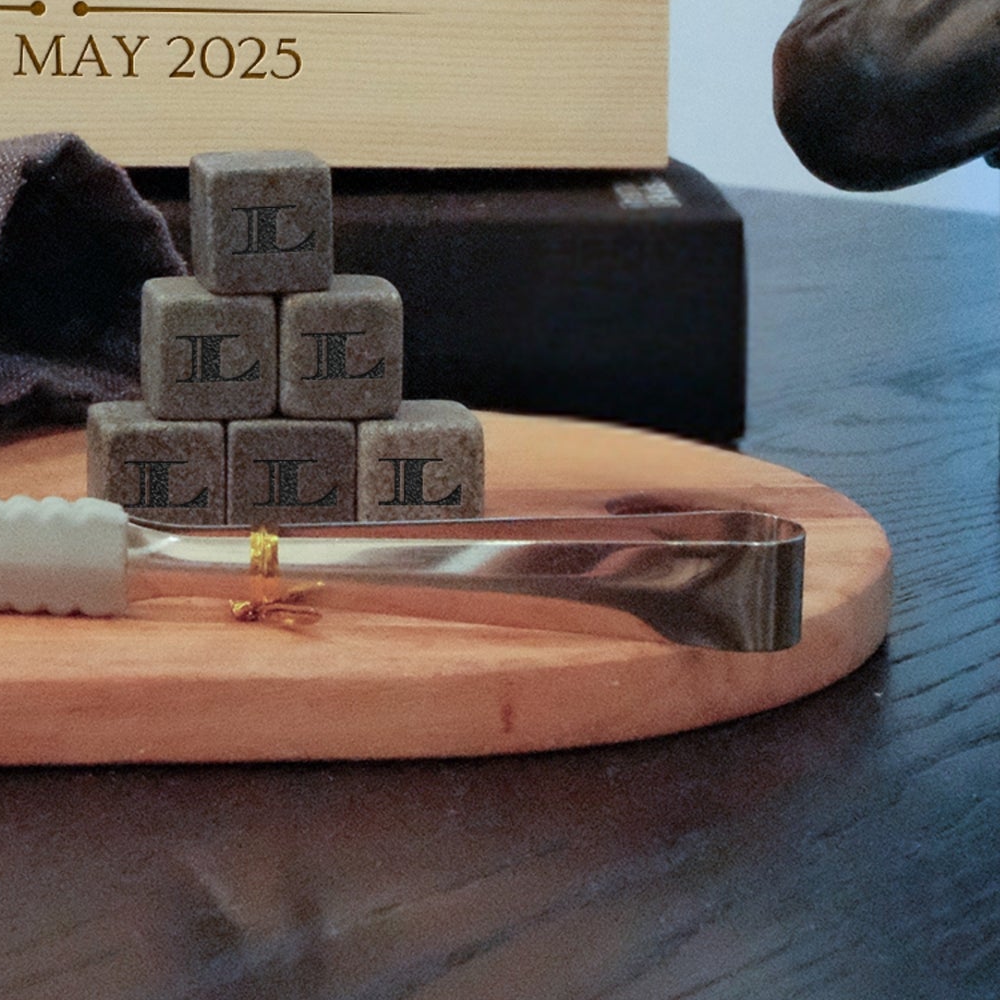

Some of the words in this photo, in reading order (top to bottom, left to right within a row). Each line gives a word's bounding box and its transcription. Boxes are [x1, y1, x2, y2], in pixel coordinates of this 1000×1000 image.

[13, 34, 150, 79] MAY
[168, 36, 303, 80] 2025
[231, 204, 315, 255] L
[175, 334, 260, 383] L
[300, 330, 385, 381] L
[124, 460, 208, 508] L
[253, 459, 337, 507] L
[378, 457, 461, 506] L
